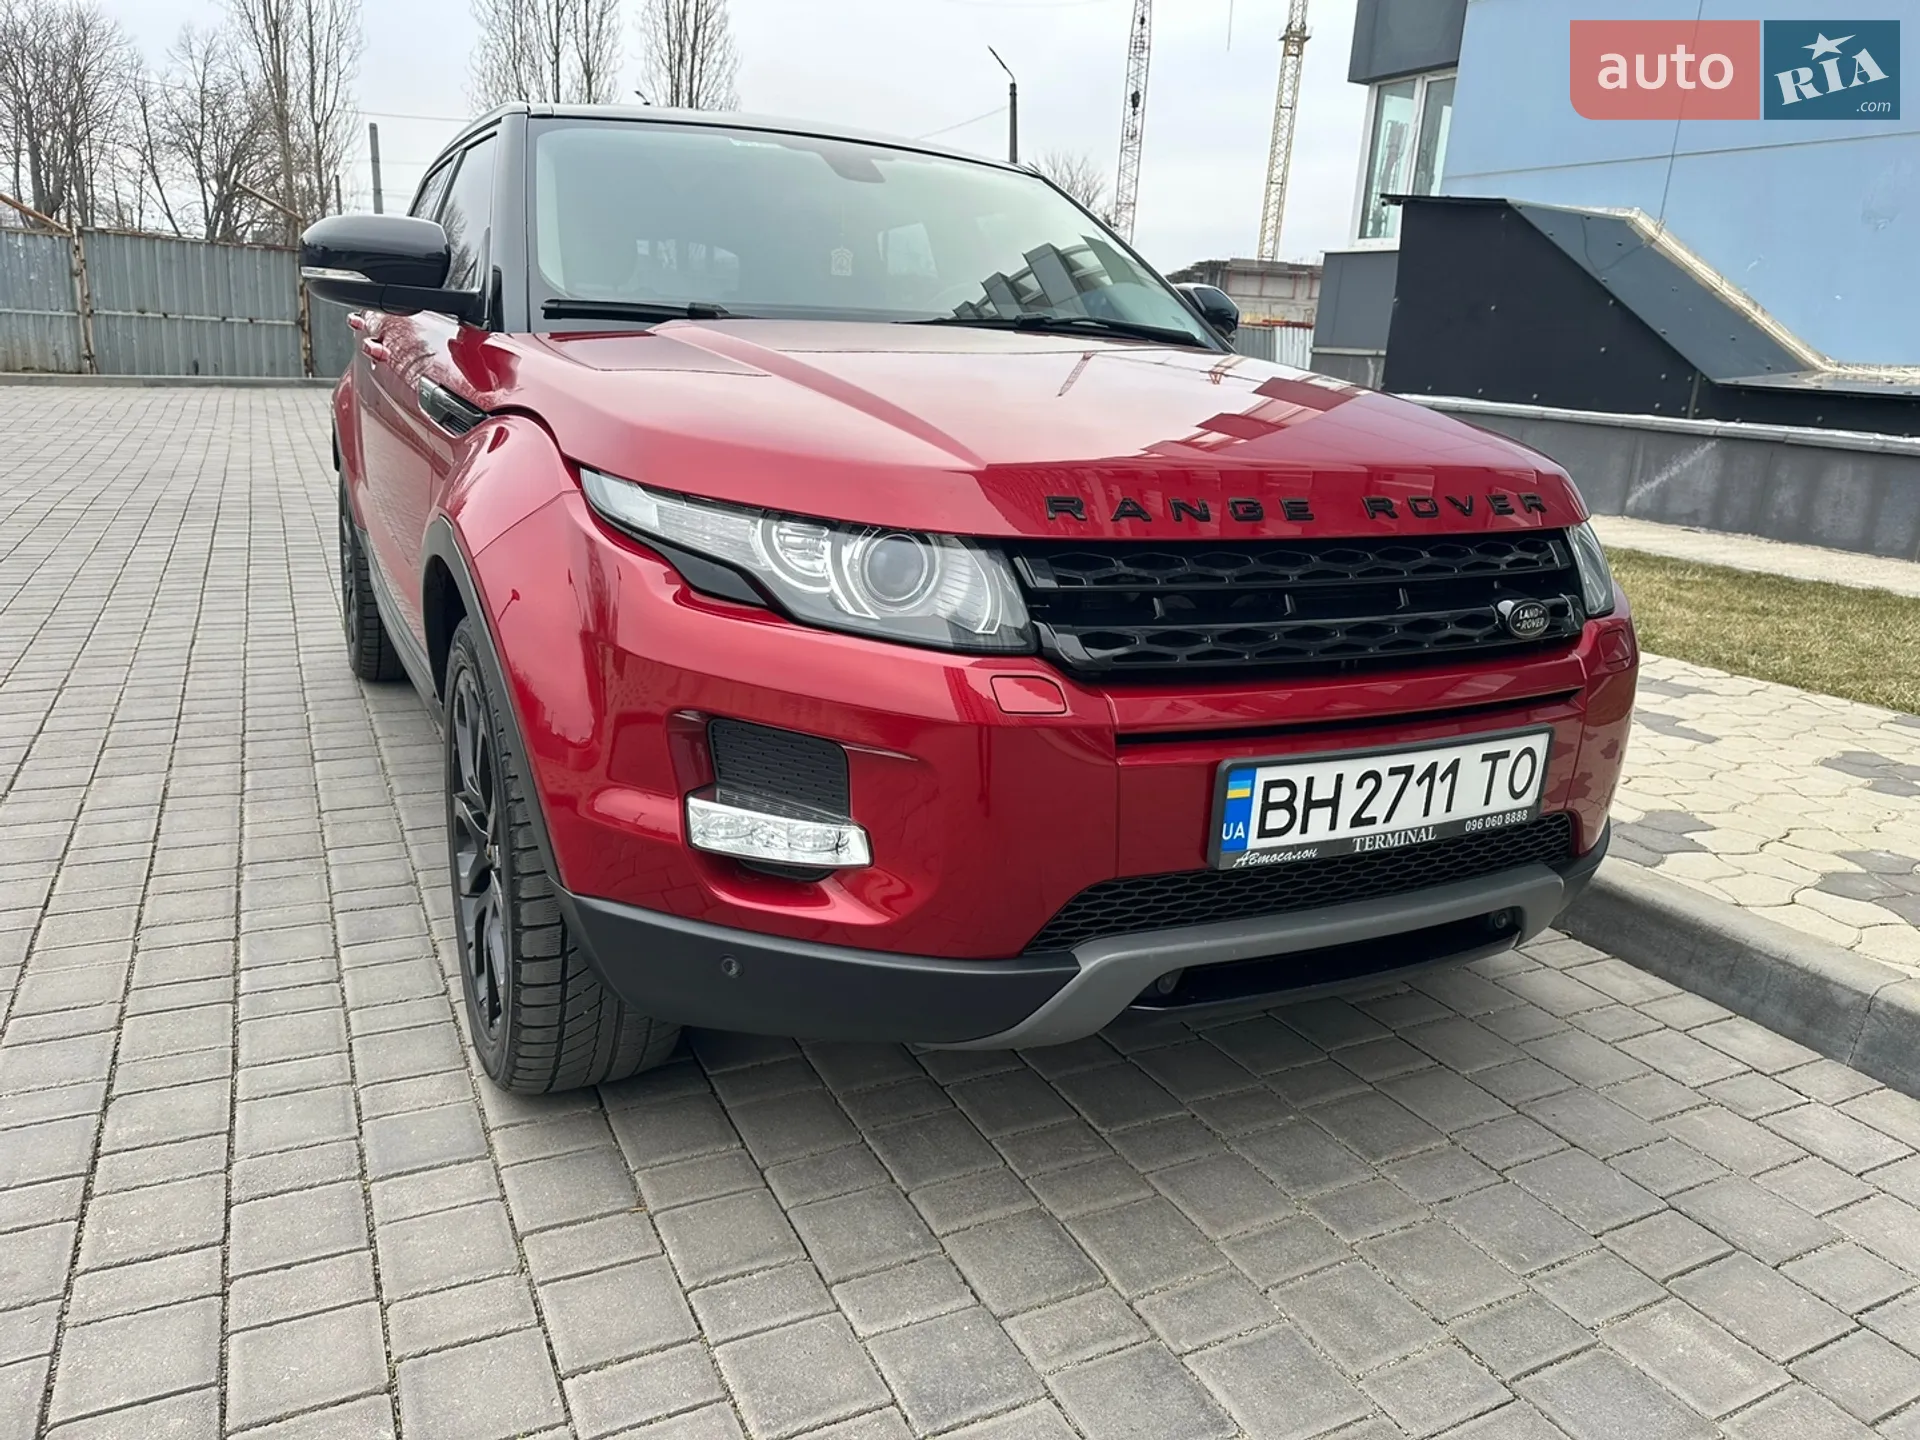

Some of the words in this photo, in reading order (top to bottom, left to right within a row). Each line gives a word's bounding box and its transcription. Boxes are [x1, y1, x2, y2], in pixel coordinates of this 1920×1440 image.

[1046, 495, 1315, 522] RANGE
[1364, 491, 1548, 519] ROVER
[1480, 746, 1538, 807] TO
[1221, 821, 1246, 840] UA
[1465, 818, 1484, 832] 096
[1504, 809, 1529, 825] 8888
[1352, 826, 1437, 852] TERMINAL
